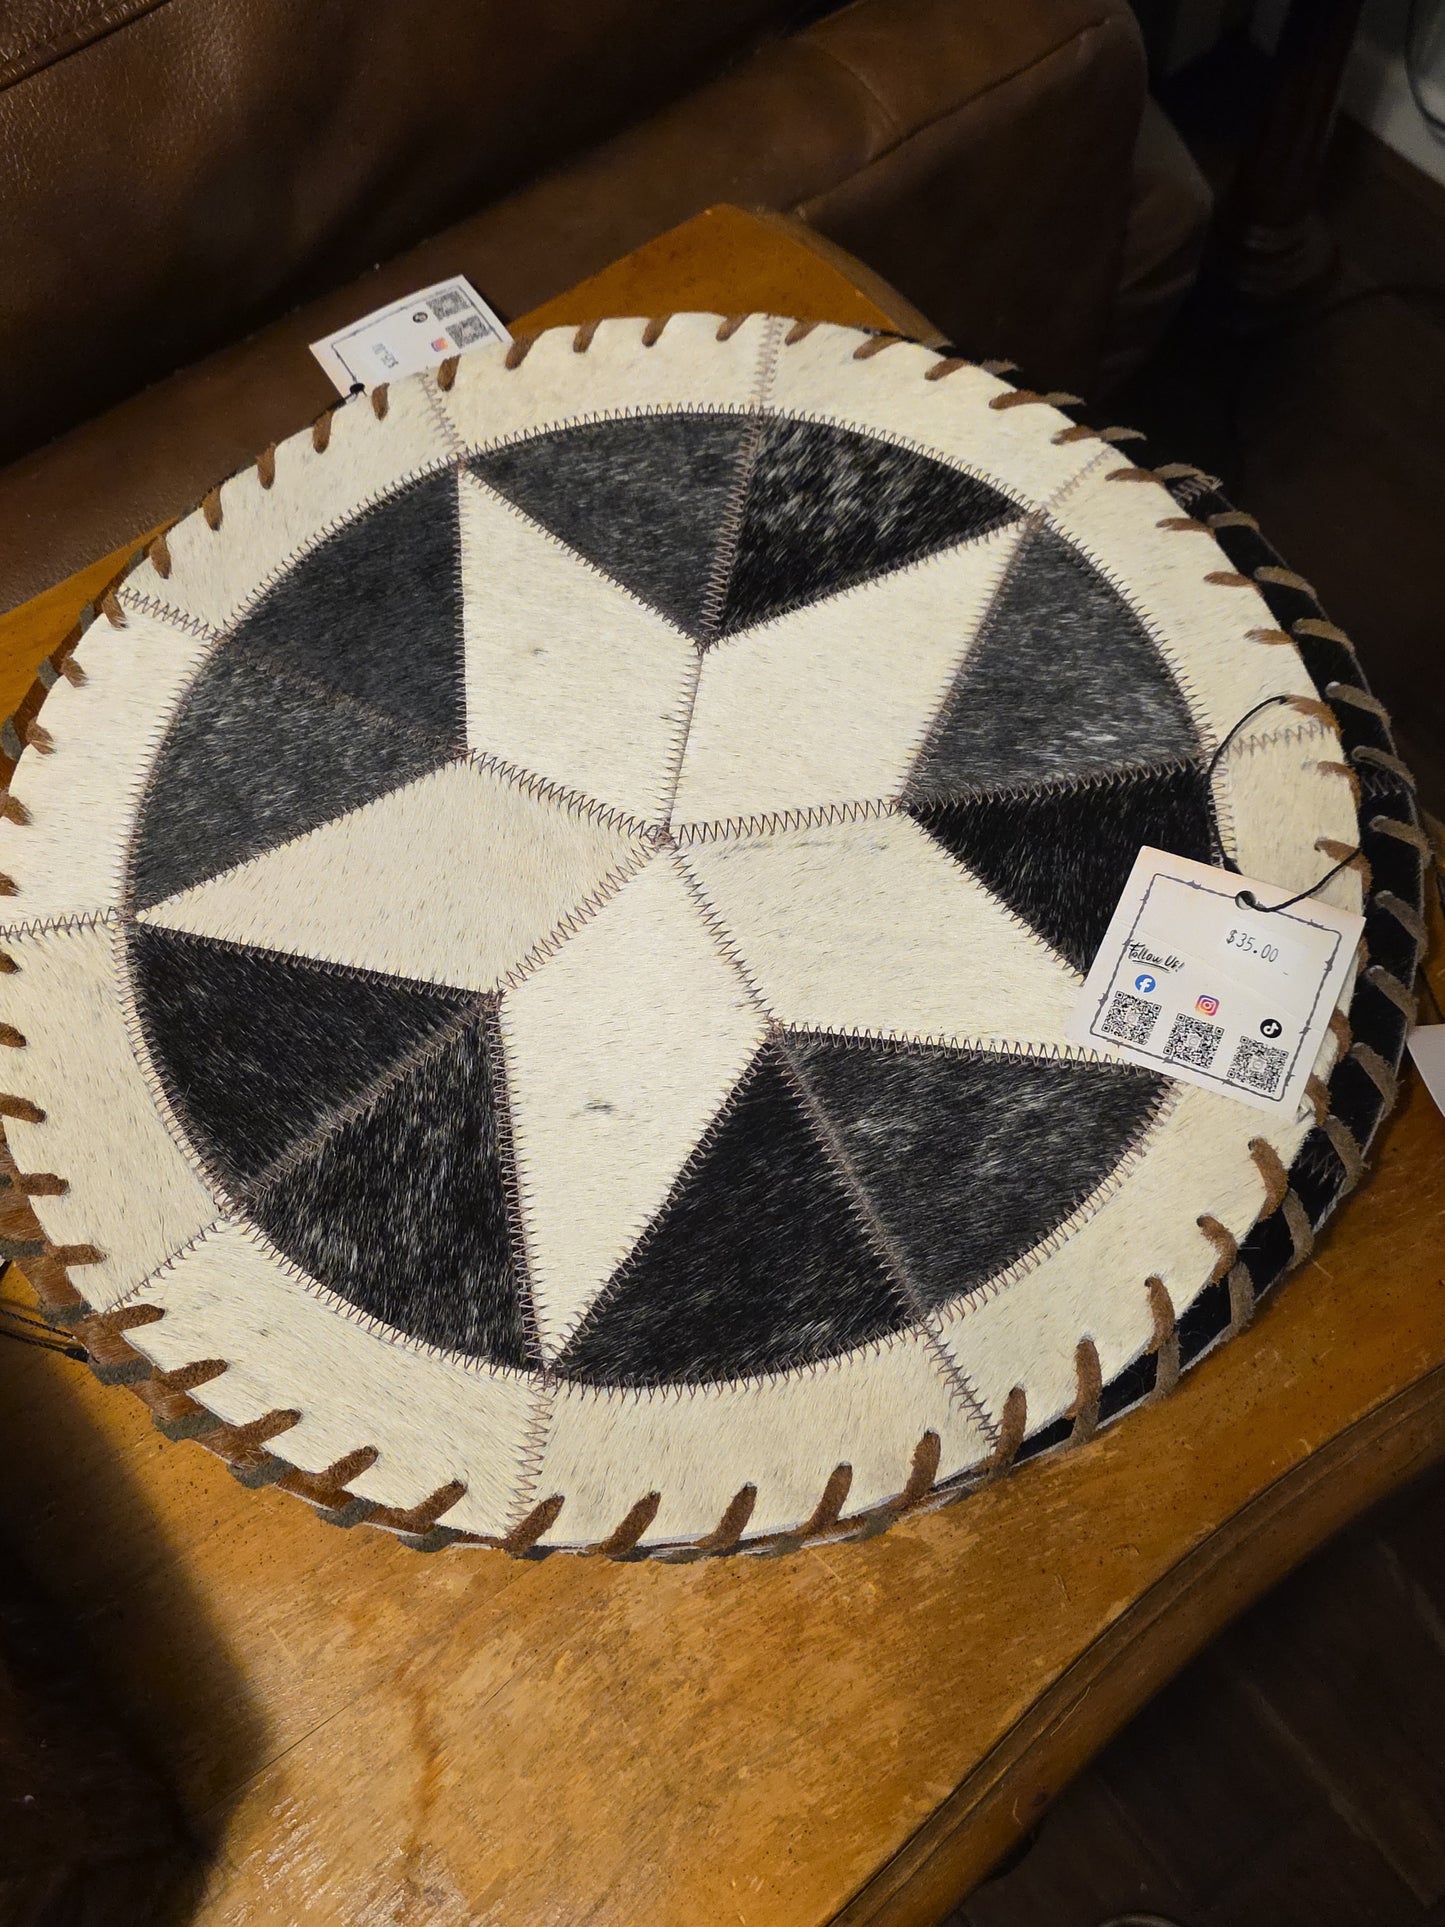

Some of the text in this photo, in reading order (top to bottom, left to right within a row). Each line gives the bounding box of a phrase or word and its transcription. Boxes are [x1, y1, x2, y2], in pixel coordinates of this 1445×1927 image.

[1128, 942, 1185, 973] Follow Us!
[1226, 929, 1279, 963] $35.00
